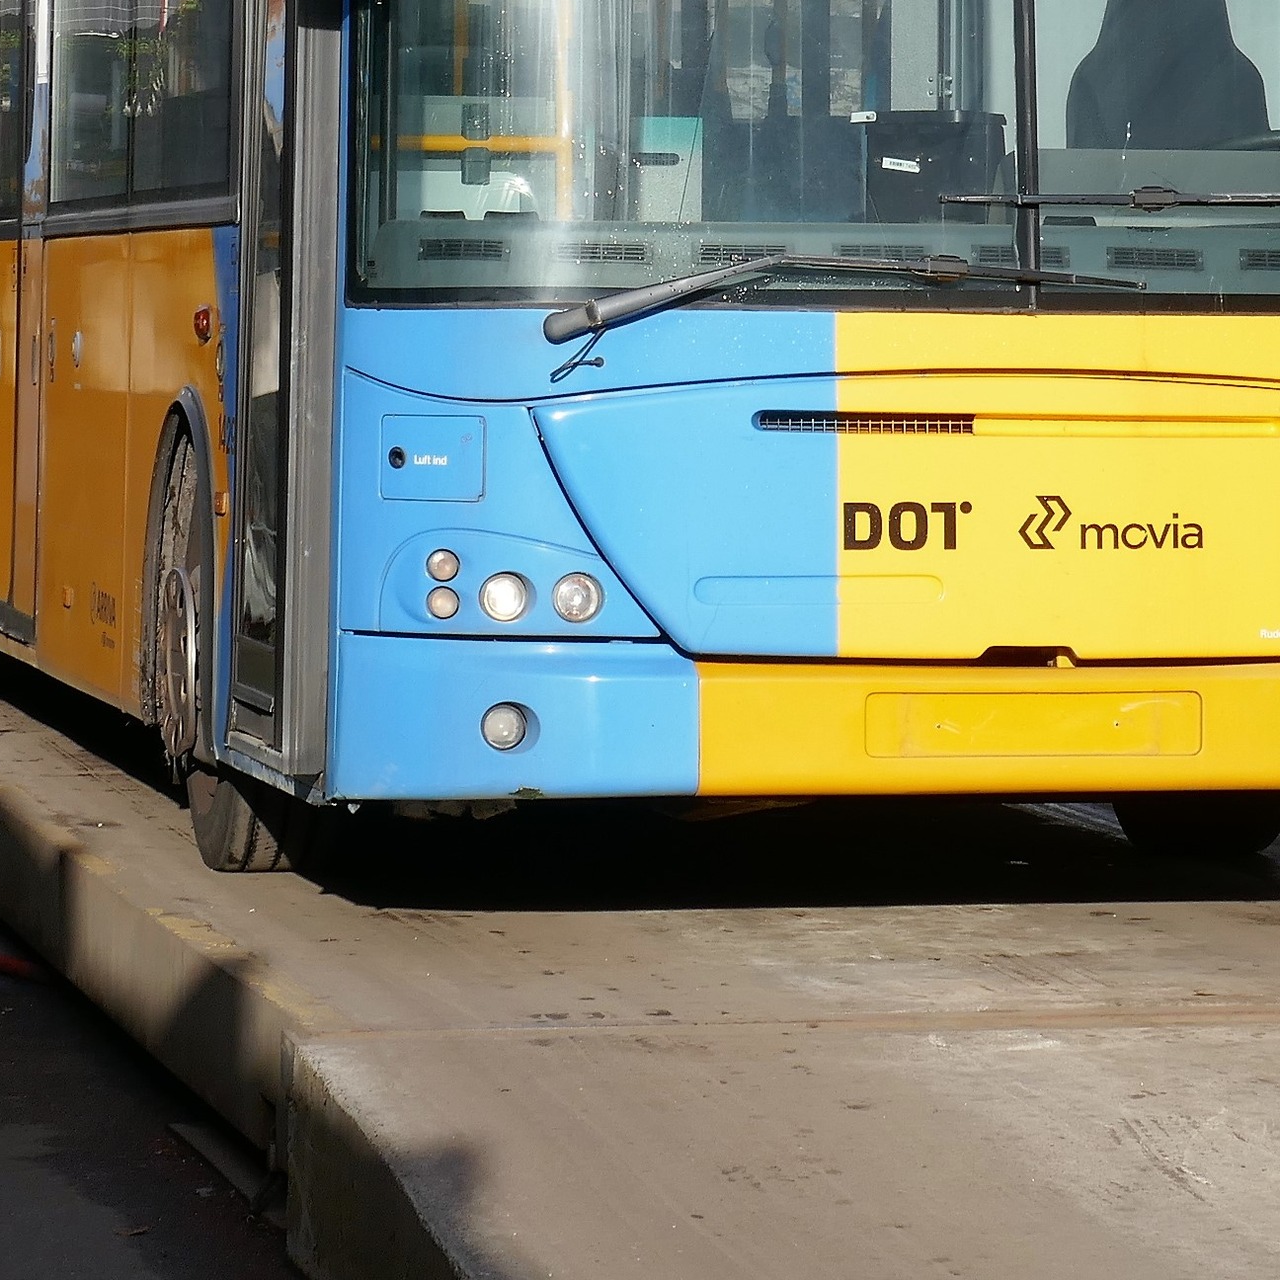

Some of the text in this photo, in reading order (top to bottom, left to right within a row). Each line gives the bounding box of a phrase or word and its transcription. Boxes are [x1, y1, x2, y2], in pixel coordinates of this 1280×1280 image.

[413, 454, 448, 466] Luft ind
[843, 501, 973, 551] DOT
[1079, 512, 1204, 550] movia
